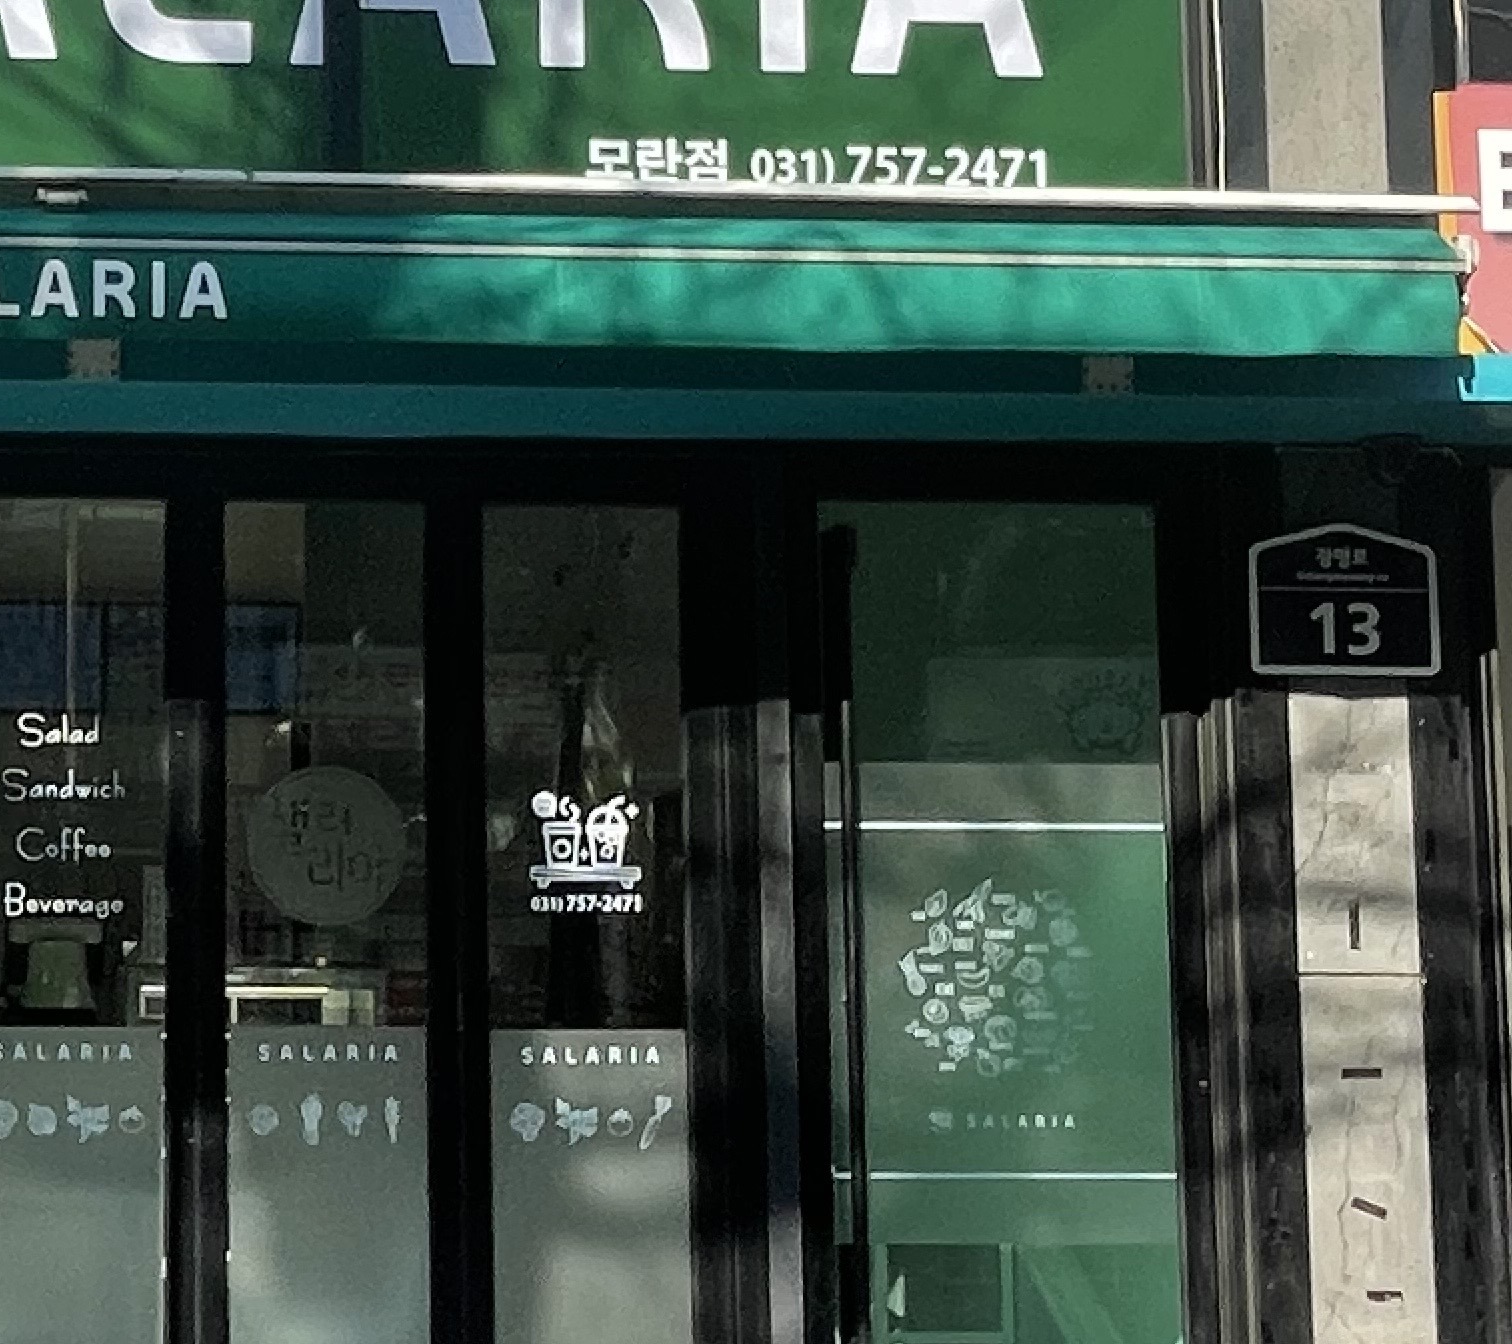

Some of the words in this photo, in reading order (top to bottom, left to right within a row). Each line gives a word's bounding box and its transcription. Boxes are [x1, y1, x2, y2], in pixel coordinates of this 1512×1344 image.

[585, 137, 729, 183] 모란점
[845, 145, 1048, 188] 757-2471
[1310, 602, 1381, 656] 13
[16, 712, 100, 748] Salad
[2, 768, 126, 802] Sandwich
[16, 826, 113, 864] Coffee
[3, 881, 124, 919] Beverage
[258, 1044, 398, 1063] SALARIA
[521, 1046, 660, 1065] SALARIA
